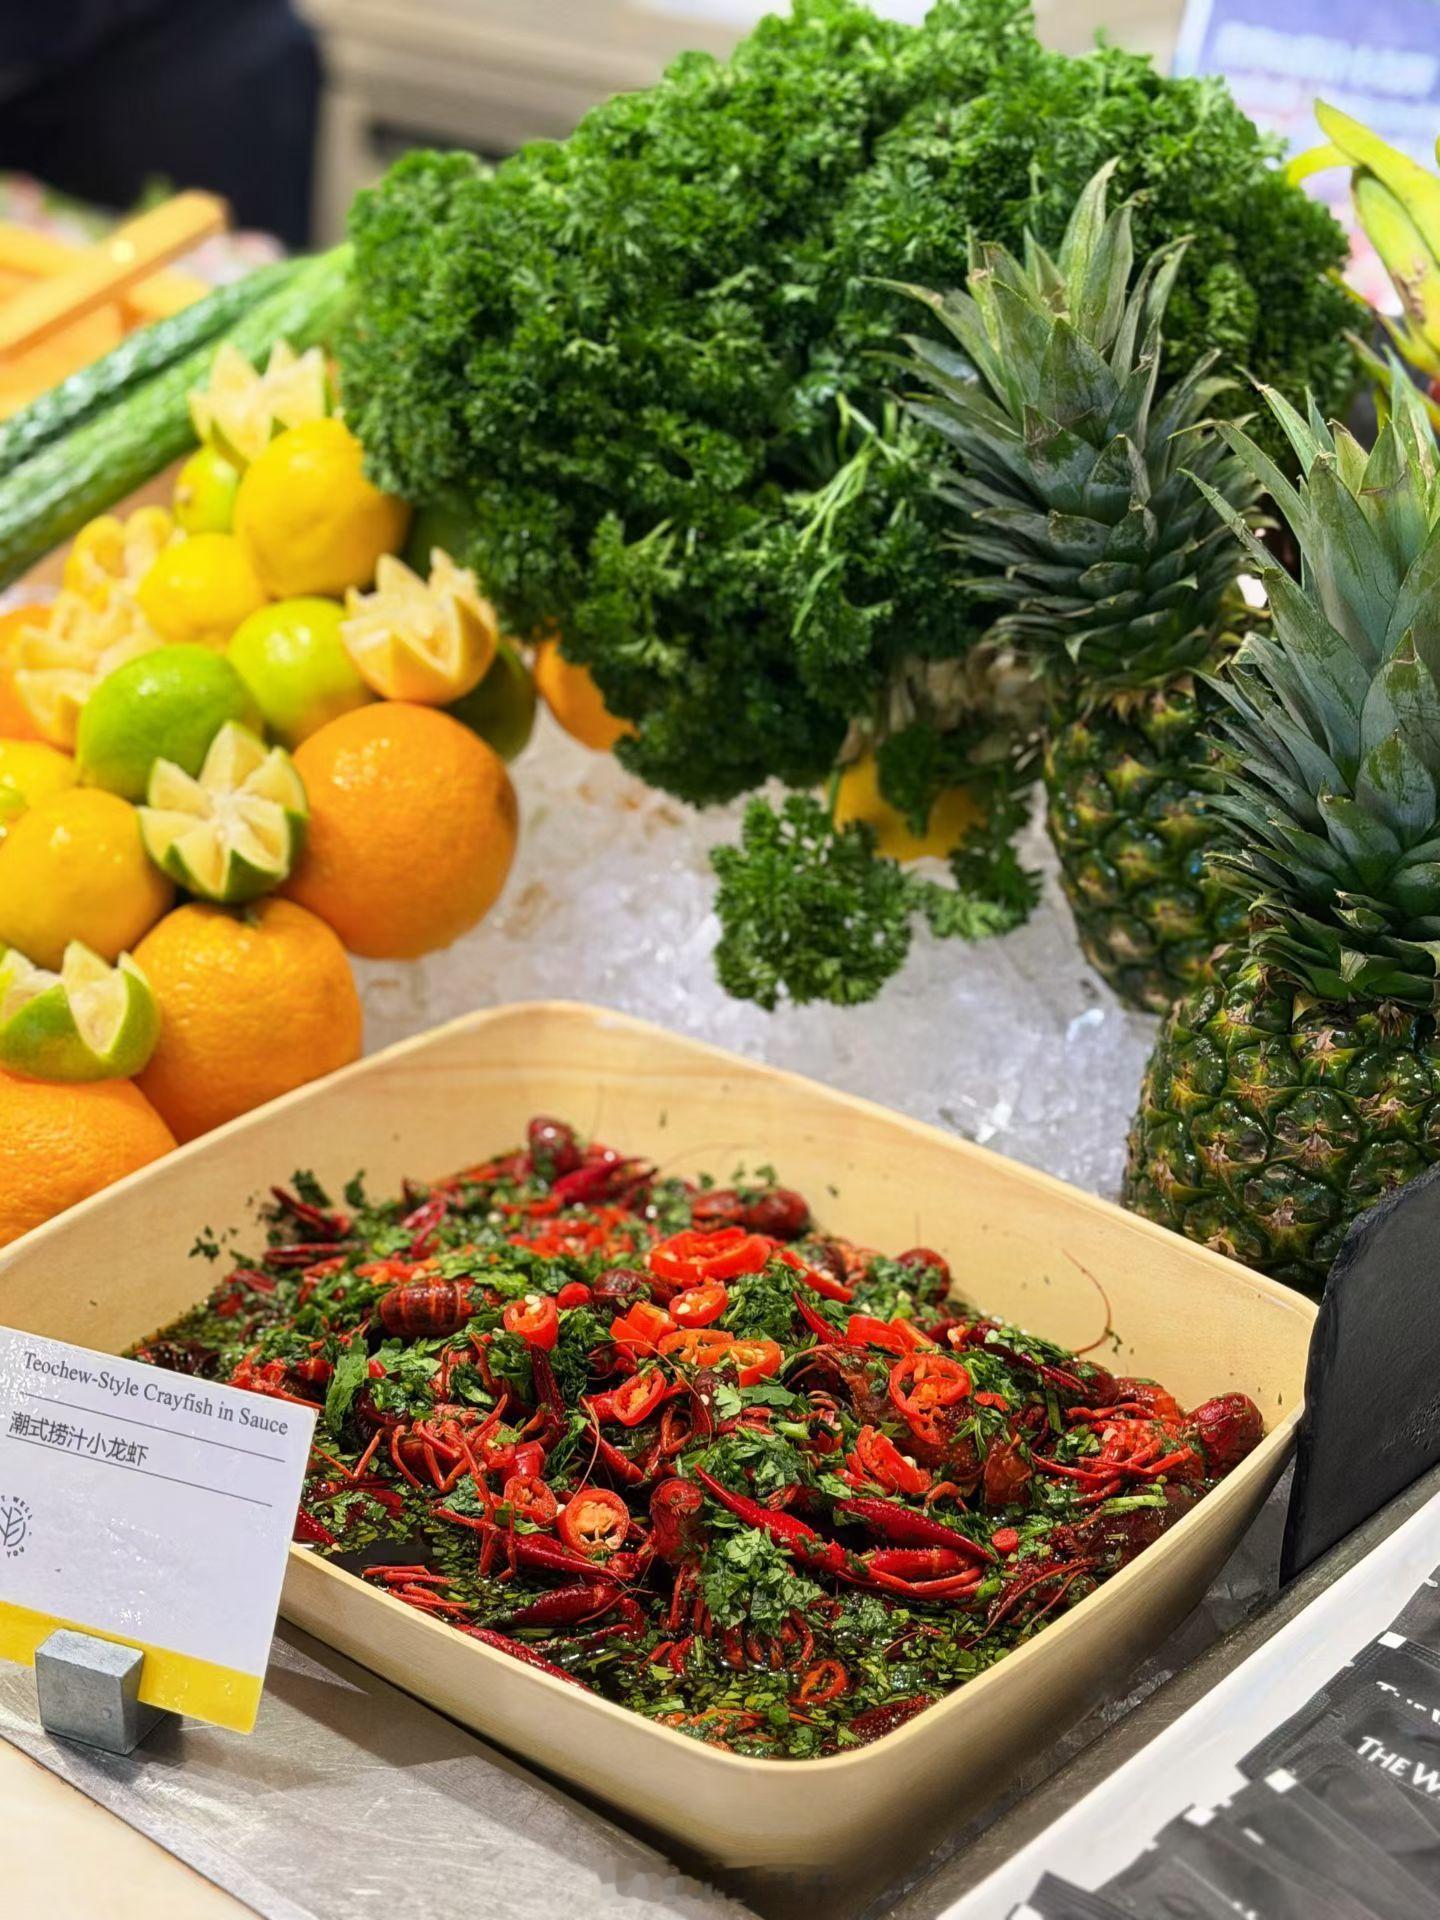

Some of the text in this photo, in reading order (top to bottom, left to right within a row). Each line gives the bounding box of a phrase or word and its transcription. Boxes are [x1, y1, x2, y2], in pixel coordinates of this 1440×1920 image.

[24, 1351, 288, 1436] Teochew-Style Crayfish in Sauce
[9, 1410, 149, 1467] 潮式捞汁小龙虾
[1357, 1736, 1440, 1794] THE W
